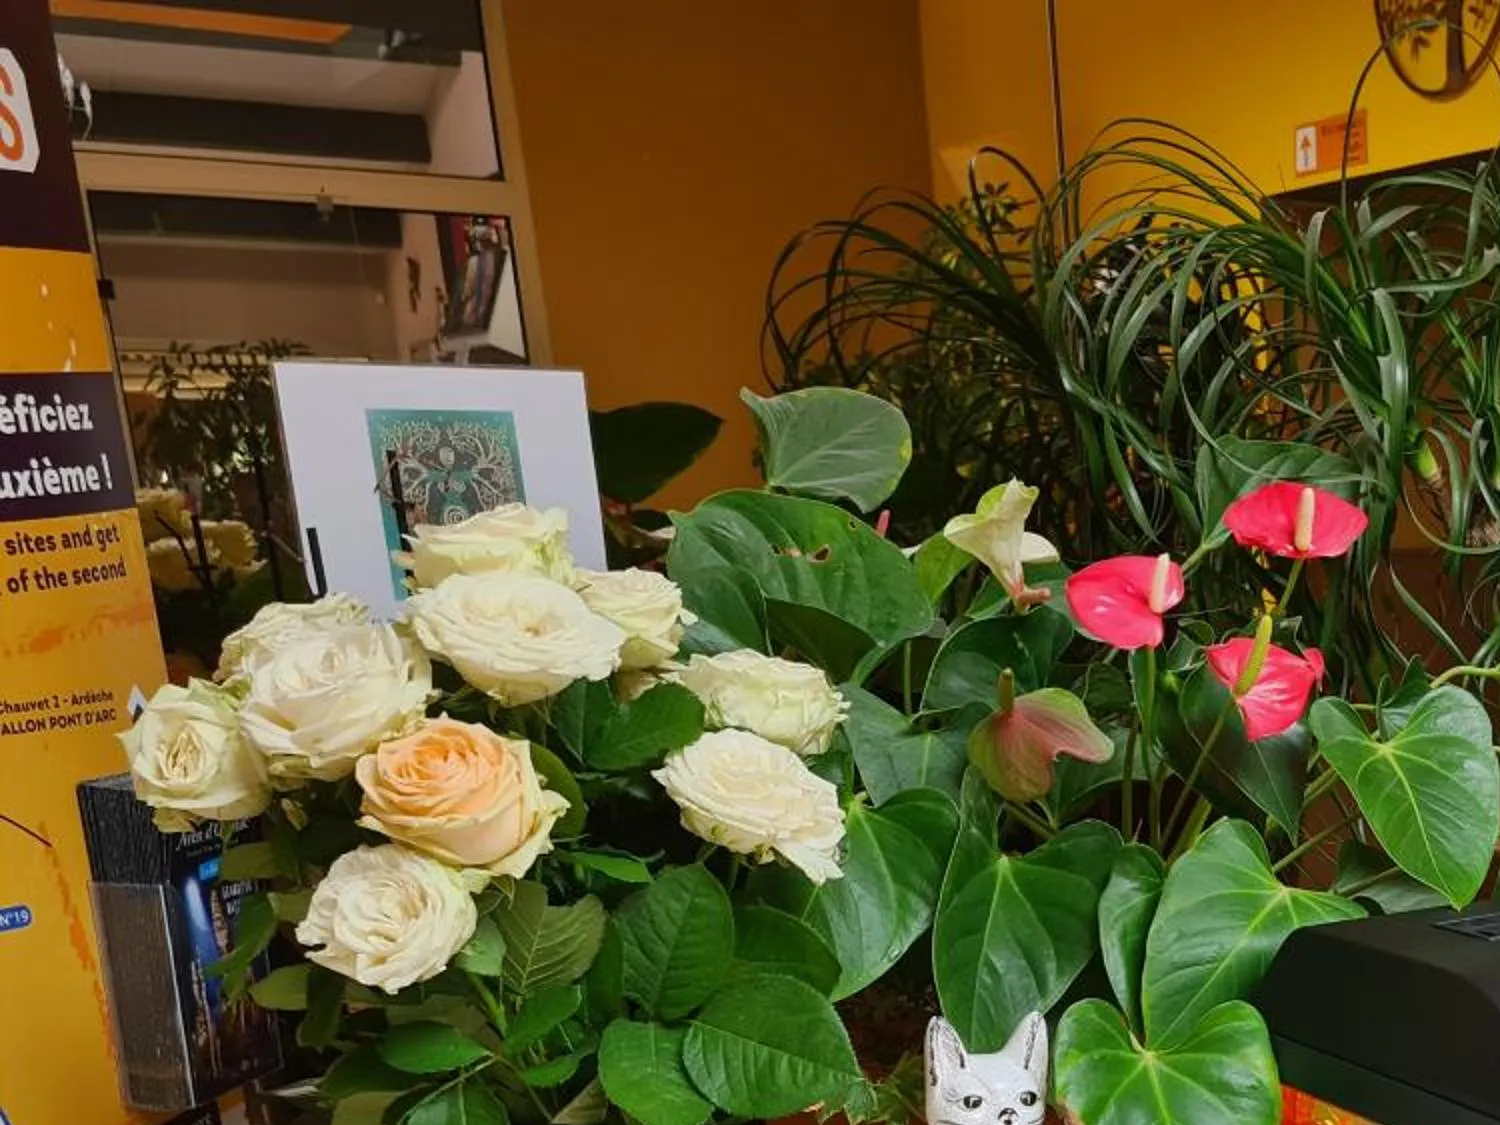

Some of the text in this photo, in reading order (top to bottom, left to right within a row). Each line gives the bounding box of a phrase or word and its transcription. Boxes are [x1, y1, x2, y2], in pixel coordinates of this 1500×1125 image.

[4, 523, 121, 556] sites and get
[7, 556, 127, 594] of the second
[48, 711, 82, 730] PONT
